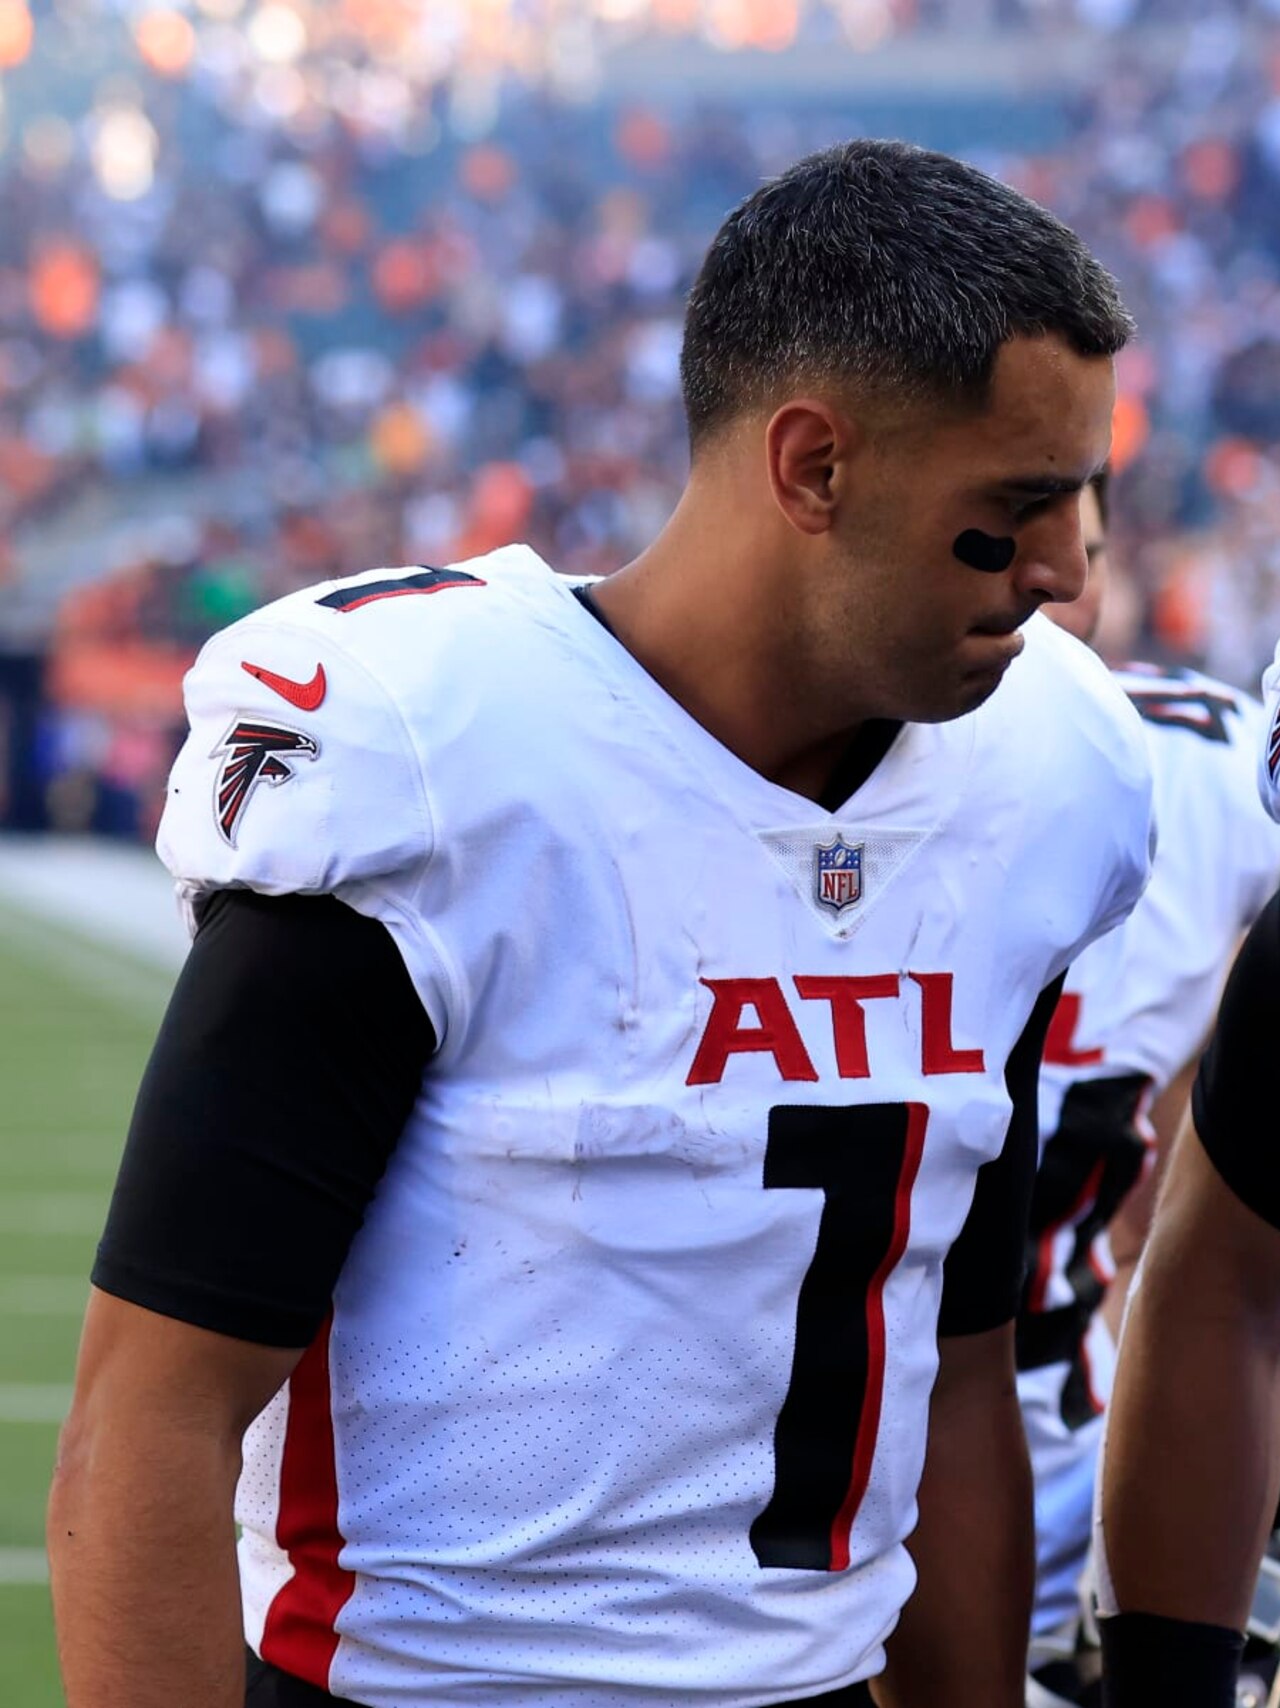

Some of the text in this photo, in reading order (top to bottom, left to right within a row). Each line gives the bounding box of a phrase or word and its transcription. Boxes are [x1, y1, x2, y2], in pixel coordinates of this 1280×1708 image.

[823, 872, 858, 903] NFL
[685, 971, 985, 1086] ATL
[749, 1101, 930, 1571] 1
